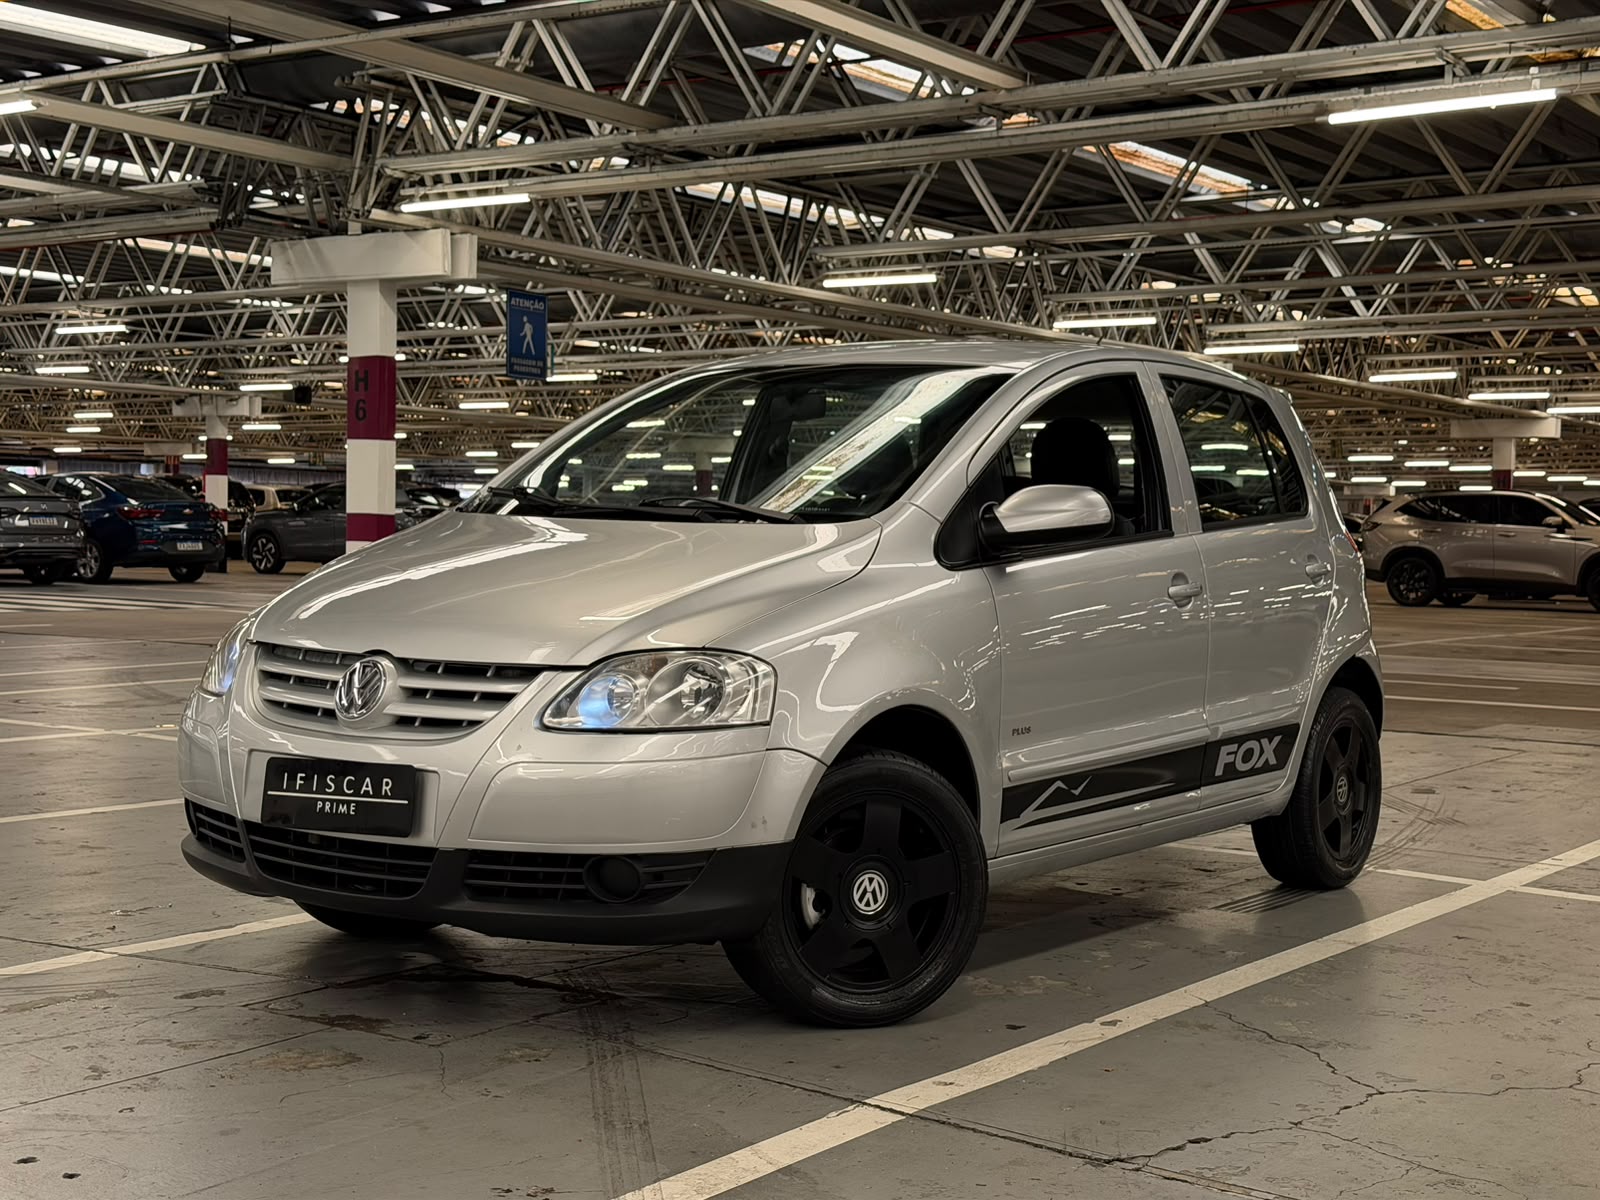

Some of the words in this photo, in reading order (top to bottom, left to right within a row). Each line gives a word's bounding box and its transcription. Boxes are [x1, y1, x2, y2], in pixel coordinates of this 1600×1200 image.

[511, 297, 545, 311] ATENÇÃO
[354, 369, 369, 392] H
[355, 398, 368, 422] 6
[1214, 734, 1283, 777] FOX
[283, 771, 393, 797] IFISCAR
[316, 800, 357, 815] PRIME
